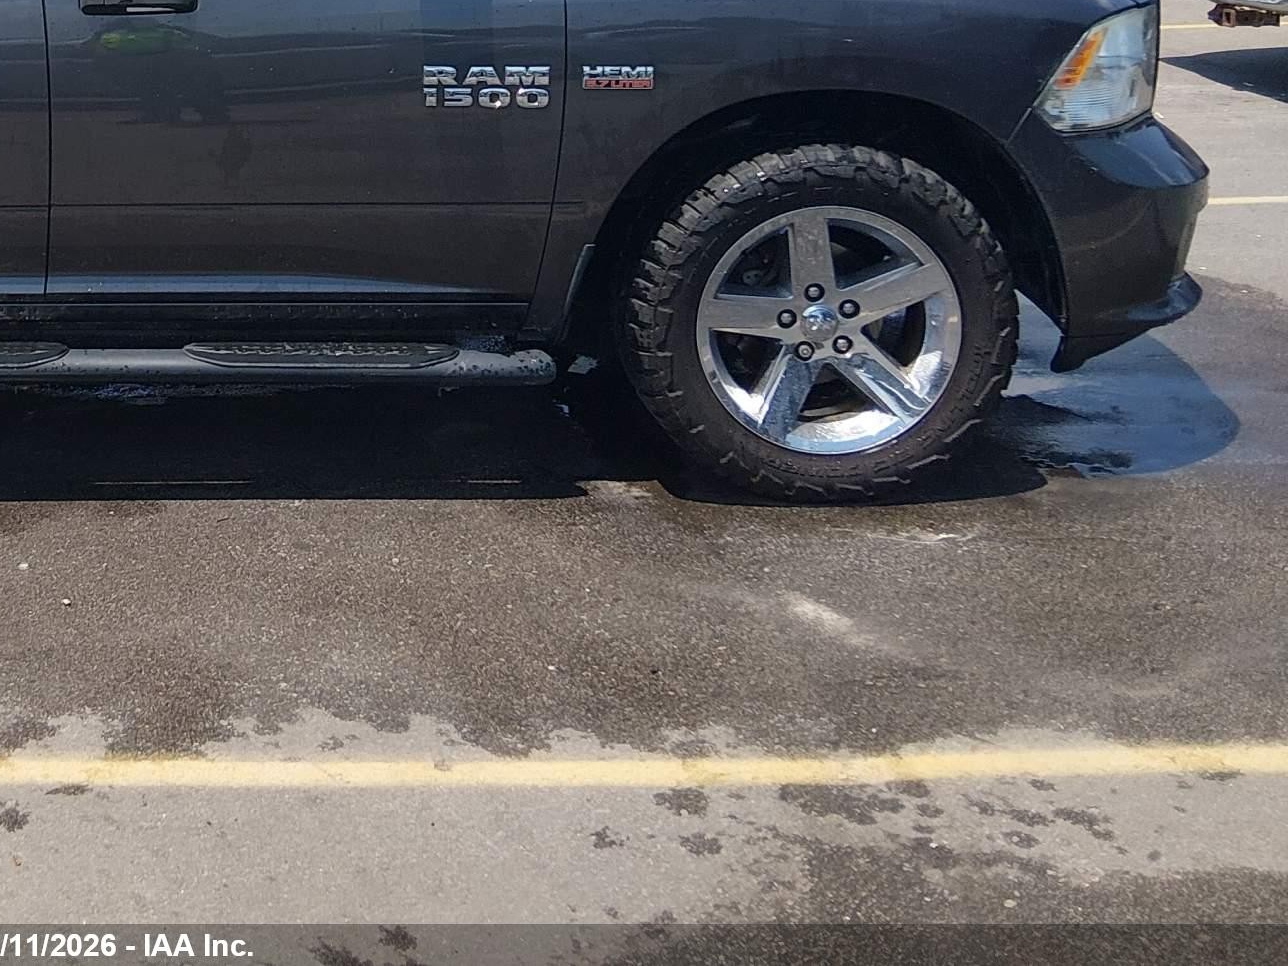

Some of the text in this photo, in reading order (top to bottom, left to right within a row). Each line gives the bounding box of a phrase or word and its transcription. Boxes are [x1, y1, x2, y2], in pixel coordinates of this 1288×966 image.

[423, 65, 551, 86] RAM
[582, 65, 654, 80] HEMI
[423, 87, 550, 108] 1500
